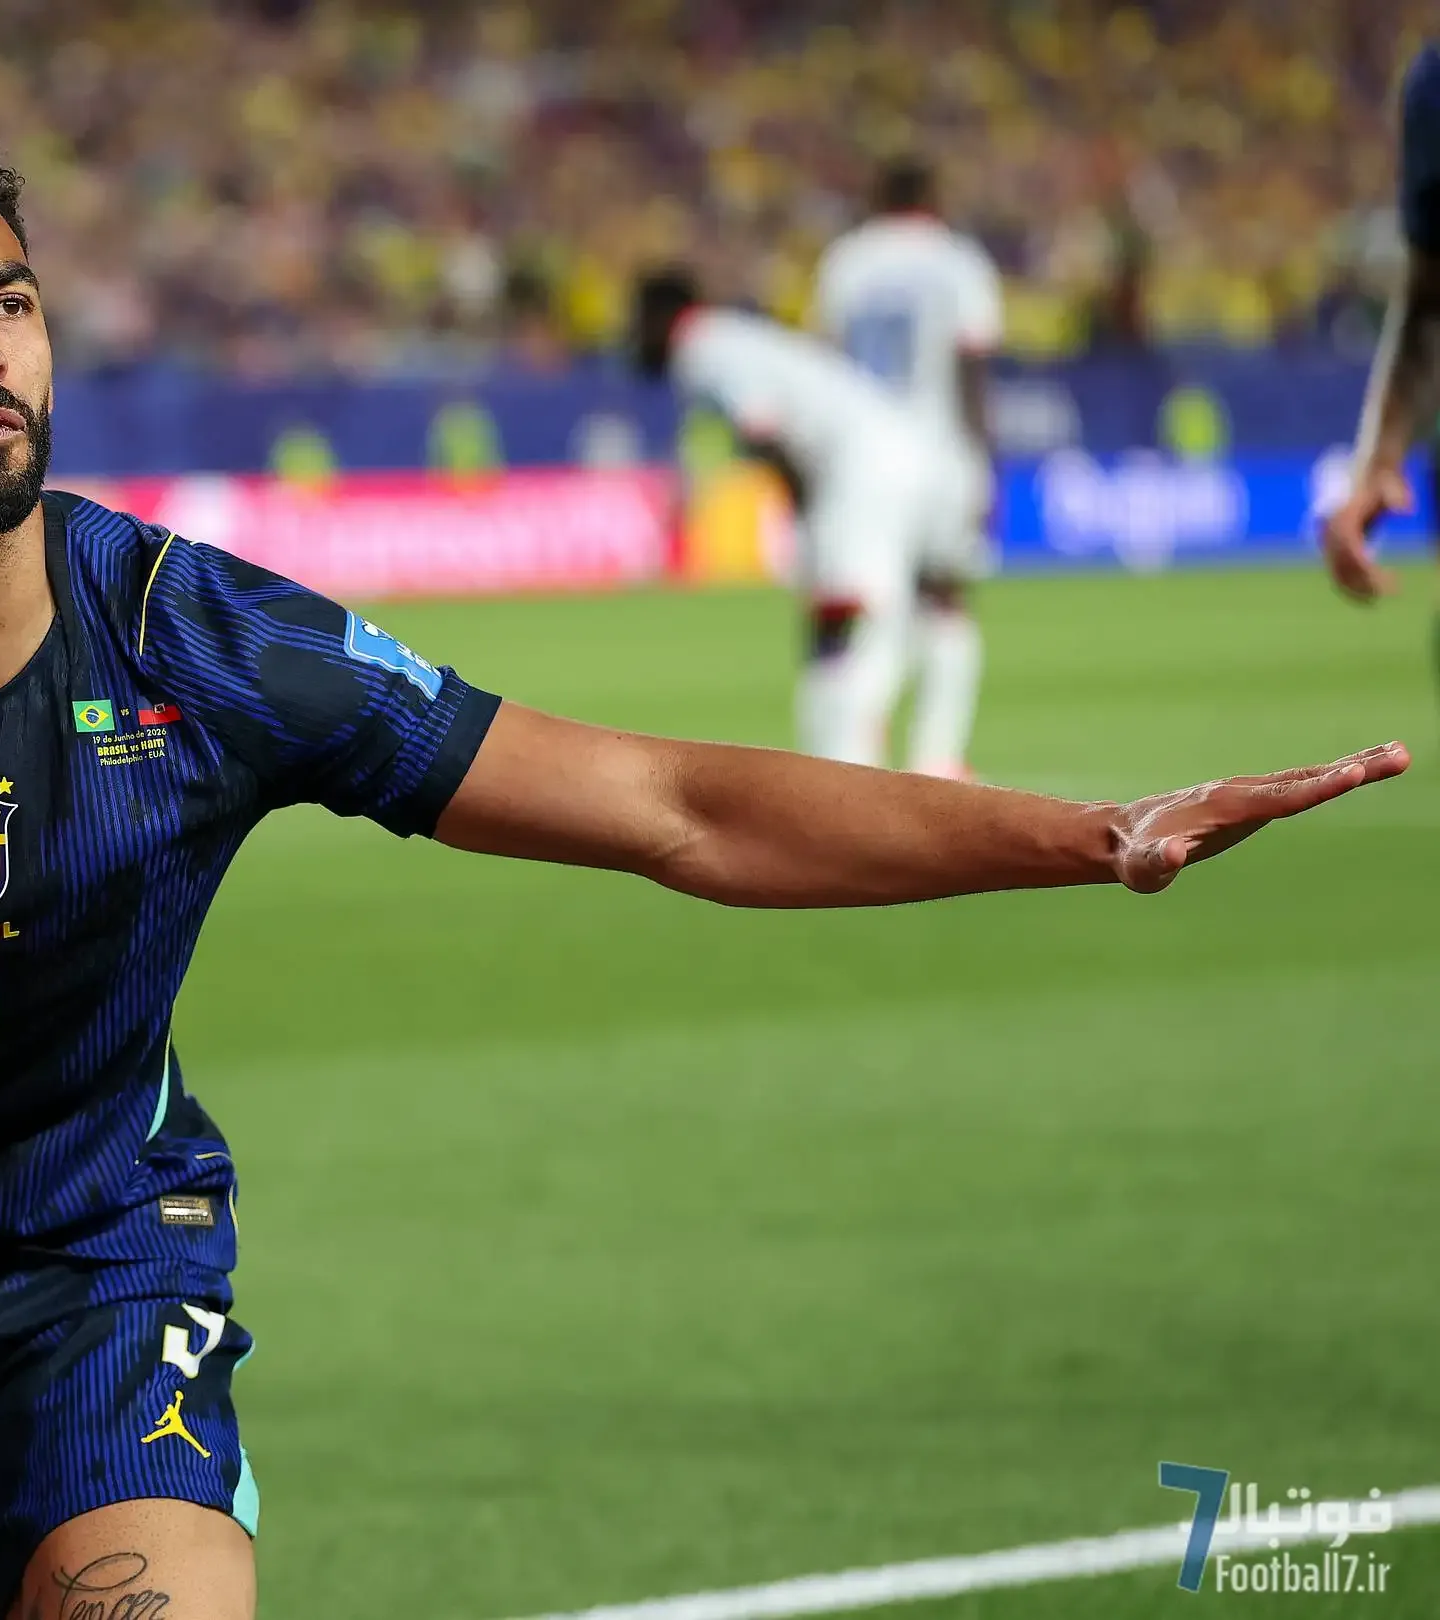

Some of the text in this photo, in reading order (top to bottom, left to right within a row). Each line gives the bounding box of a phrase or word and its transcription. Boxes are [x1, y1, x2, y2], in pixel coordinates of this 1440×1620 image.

[92, 728, 167, 744] 19 de Junho de 2026
[100, 754, 143, 766] Philadelphia
[148, 749, 166, 759] EUA
